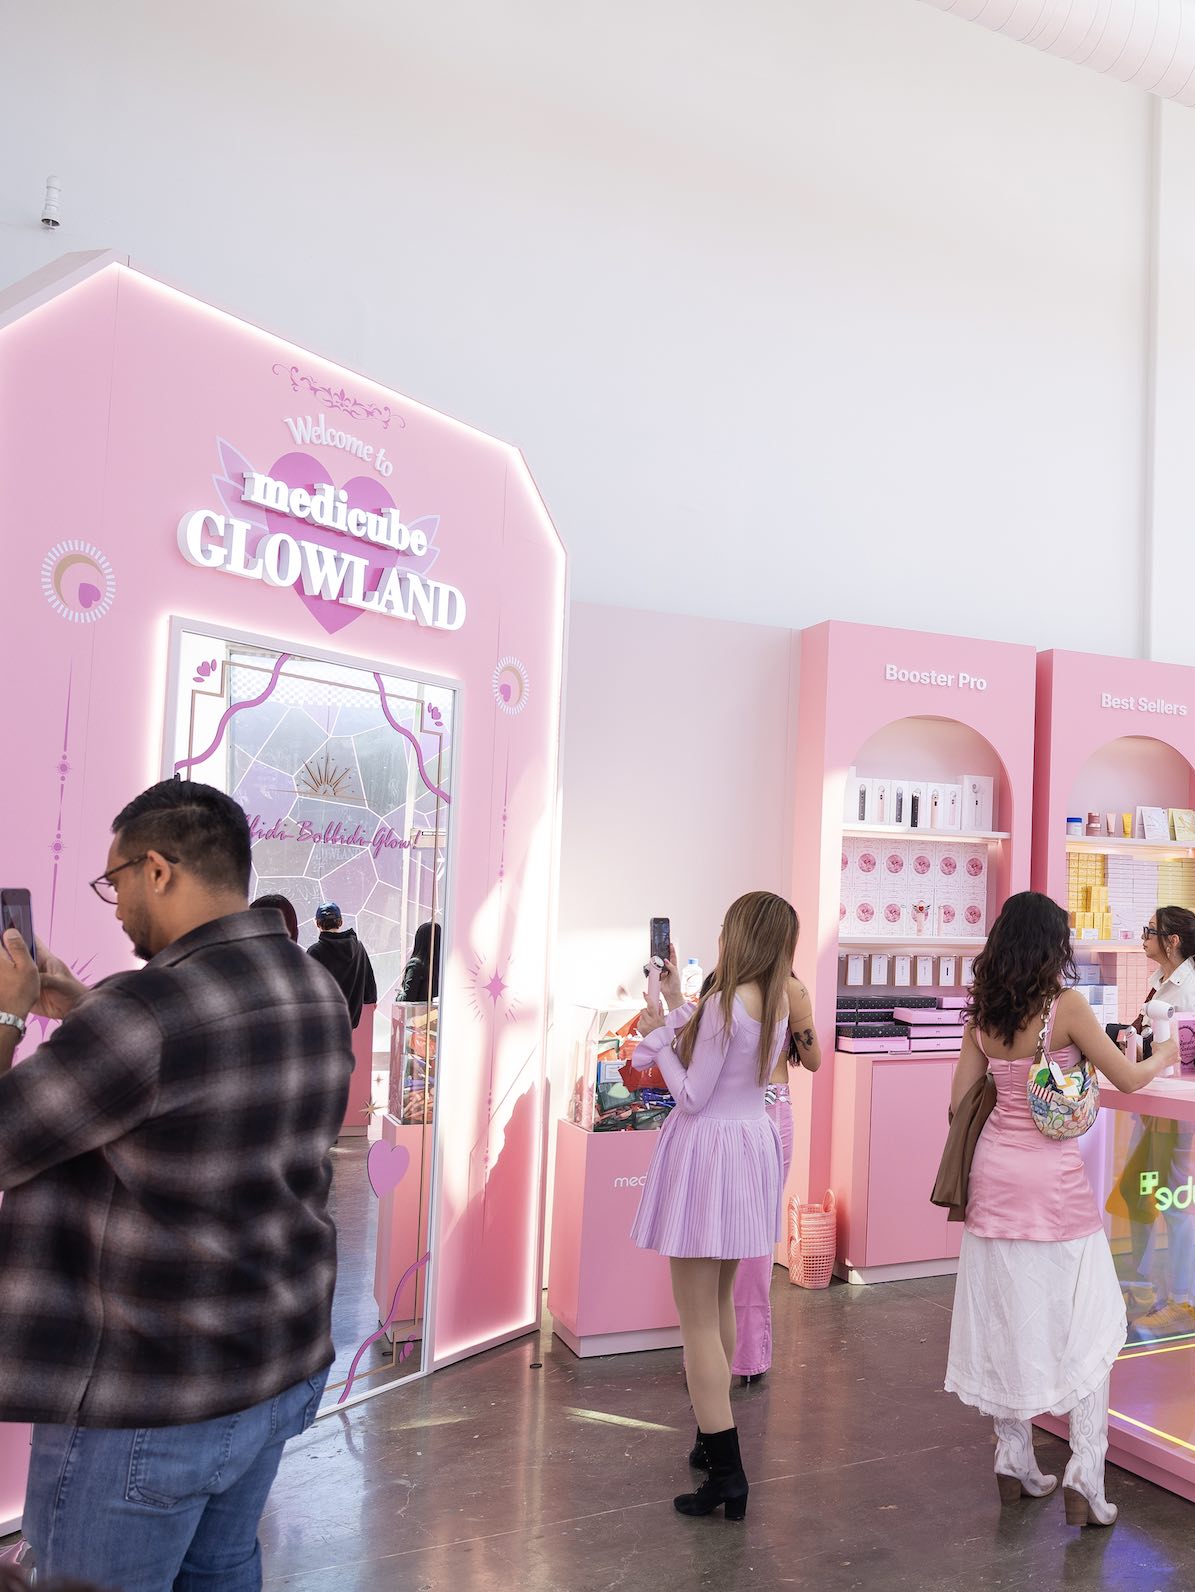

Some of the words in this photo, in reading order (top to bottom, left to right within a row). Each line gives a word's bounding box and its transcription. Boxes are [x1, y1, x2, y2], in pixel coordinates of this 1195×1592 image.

[285, 414, 374, 463] Welcome
[375, 447, 393, 478] to
[241, 471, 429, 557] medicube
[178, 508, 467, 632] GLOWLAND
[885, 664, 955, 687] Booster
[958, 672, 987, 691] Pro
[1101, 692, 1135, 712] Best
[1138, 697, 1188, 717] Sellers
